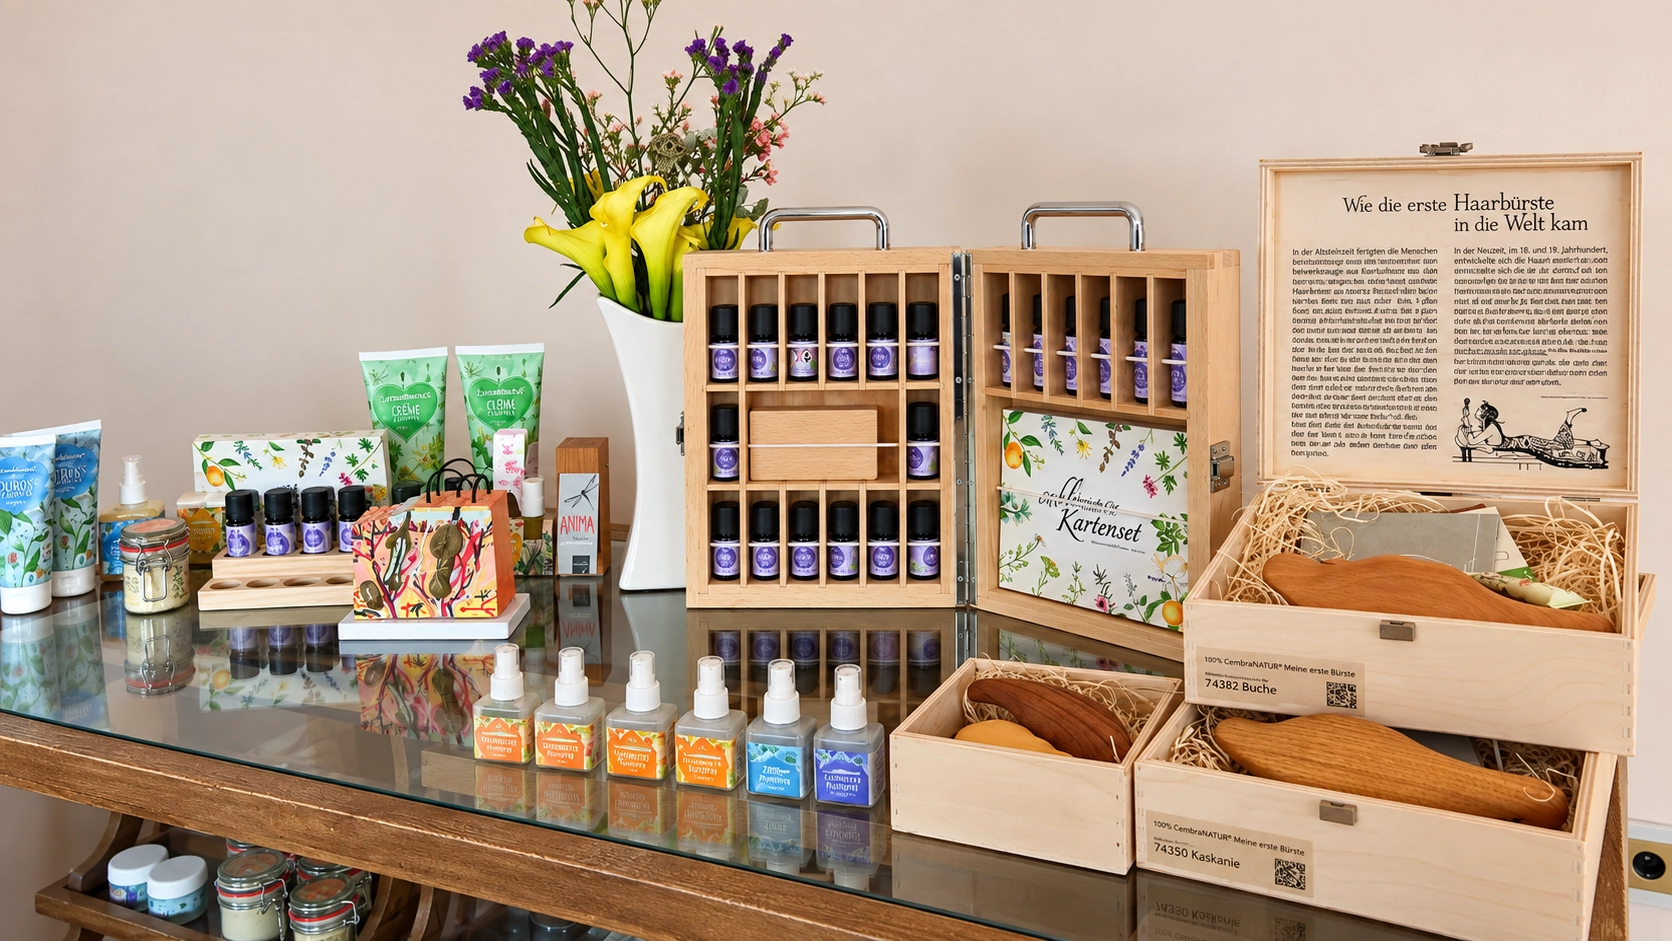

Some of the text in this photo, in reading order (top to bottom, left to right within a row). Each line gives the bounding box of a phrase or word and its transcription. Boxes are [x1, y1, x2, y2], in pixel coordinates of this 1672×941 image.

[1343, 192, 1555, 212] Wie die erste Haarbürste
[1454, 213, 1589, 232] in die Welt kam
[1292, 248, 1299, 256] In
[1453, 247, 1461, 255] In
[1477, 247, 1506, 255] Neuzeit,
[1532, 246, 1547, 254] und
[1561, 246, 1609, 255] Jahrhundert,
[1514, 256, 1526, 264] die
[559, 515, 595, 535] ANIMA
[1056, 508, 1142, 543] Kartenset
[1204, 656, 1223, 664] 100%
[1284, 664, 1308, 673] Meine
[1330, 668, 1356, 678] Bürste
[1205, 678, 1277, 695] 74382 Buche
[1153, 820, 1173, 830] 100%
[1233, 836, 1257, 847] Meine
[1259, 842, 1278, 851] erste
[1280, 845, 1305, 856] Bürste
[1154, 842, 1188, 858] 74350
[1191, 850, 1241, 869] Kaskanie
